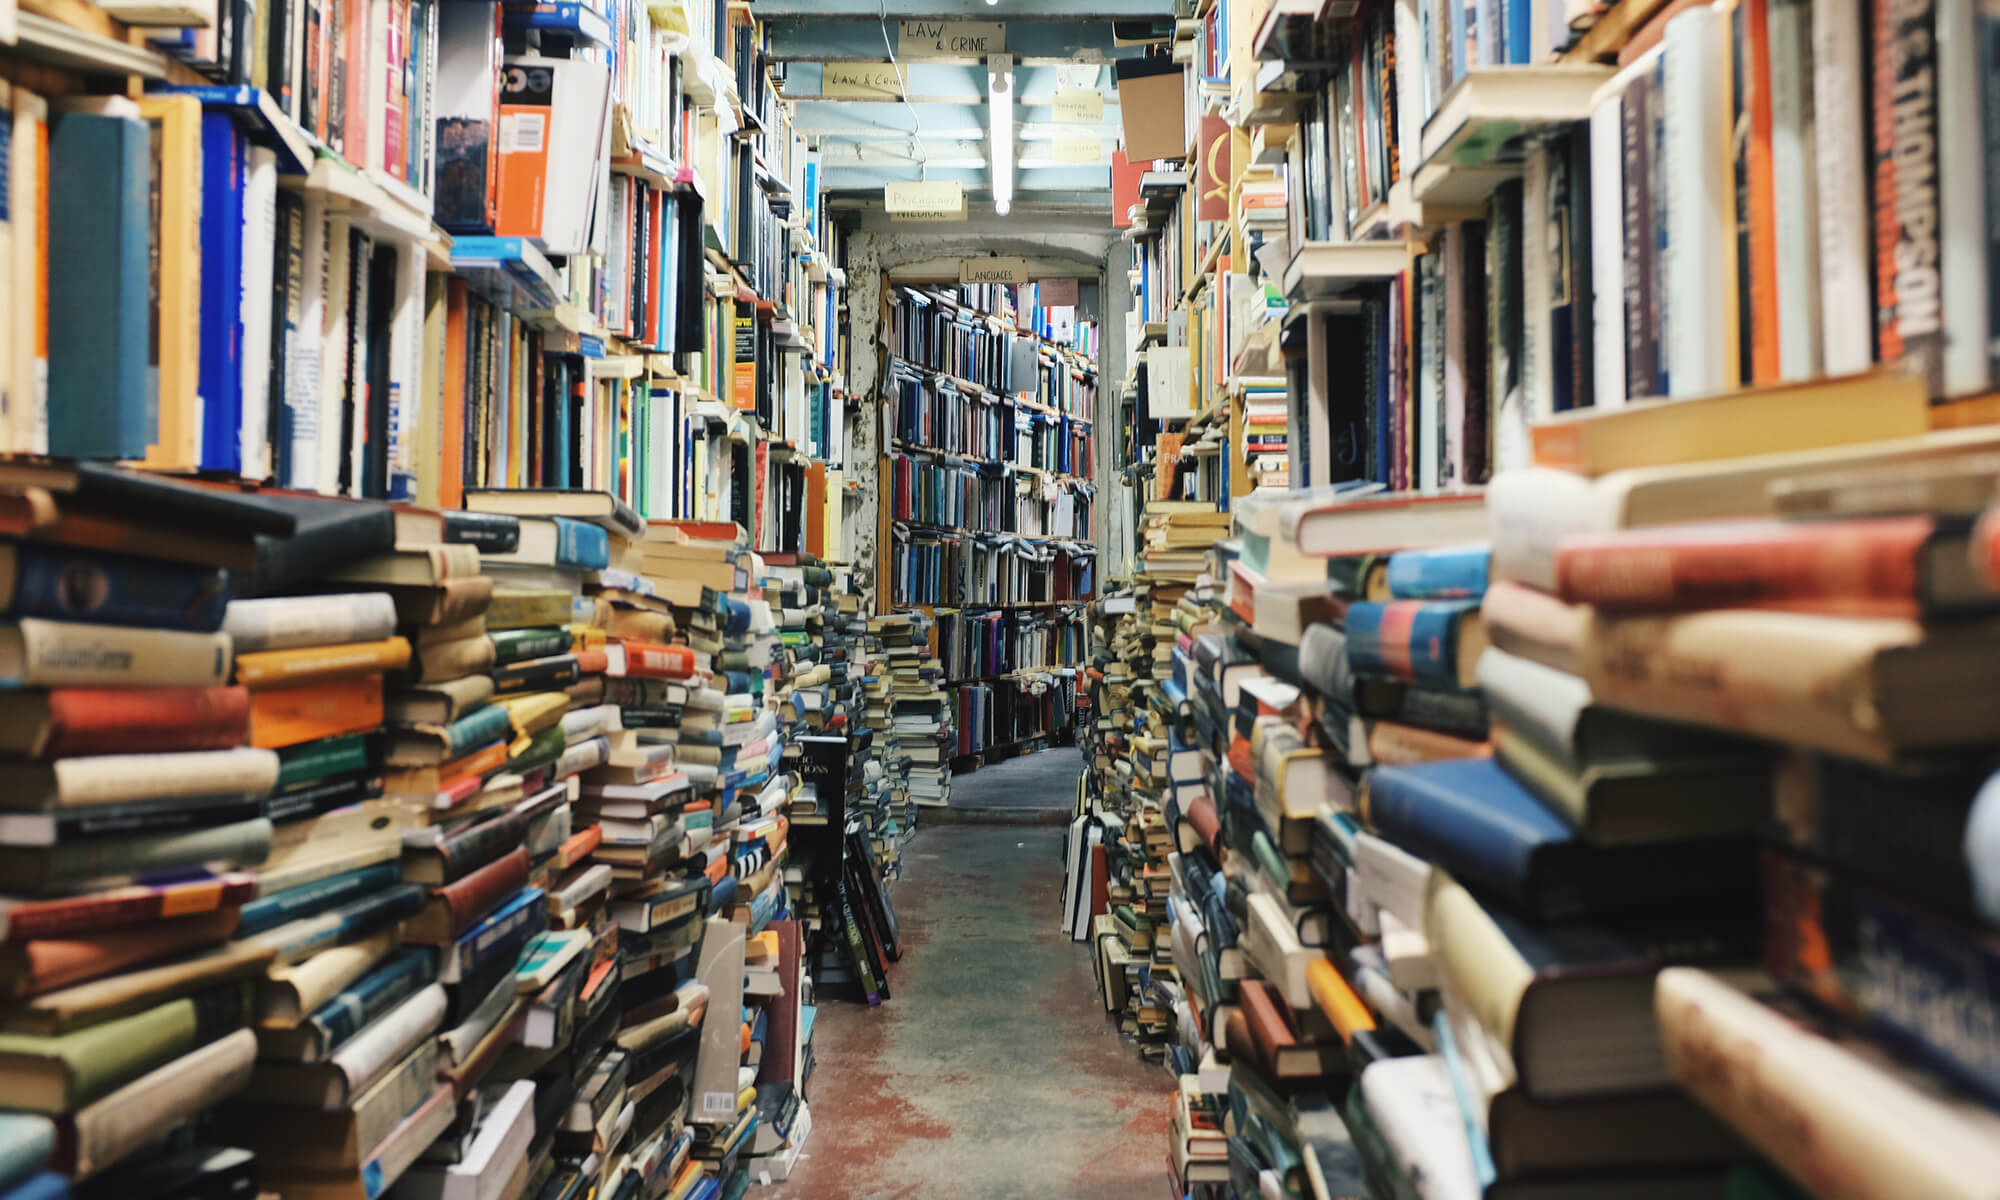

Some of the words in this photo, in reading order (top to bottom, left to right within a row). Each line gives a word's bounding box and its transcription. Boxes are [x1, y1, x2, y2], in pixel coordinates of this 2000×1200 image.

[906, 22, 945, 38] LAW
[935, 40, 944, 51] &
[950, 36, 988, 52] CRIME
[831, 71, 858, 85] LAW
[1892, 65, 1941, 338] THOMPSON
[966, 263, 1014, 281] LANGUAGES
